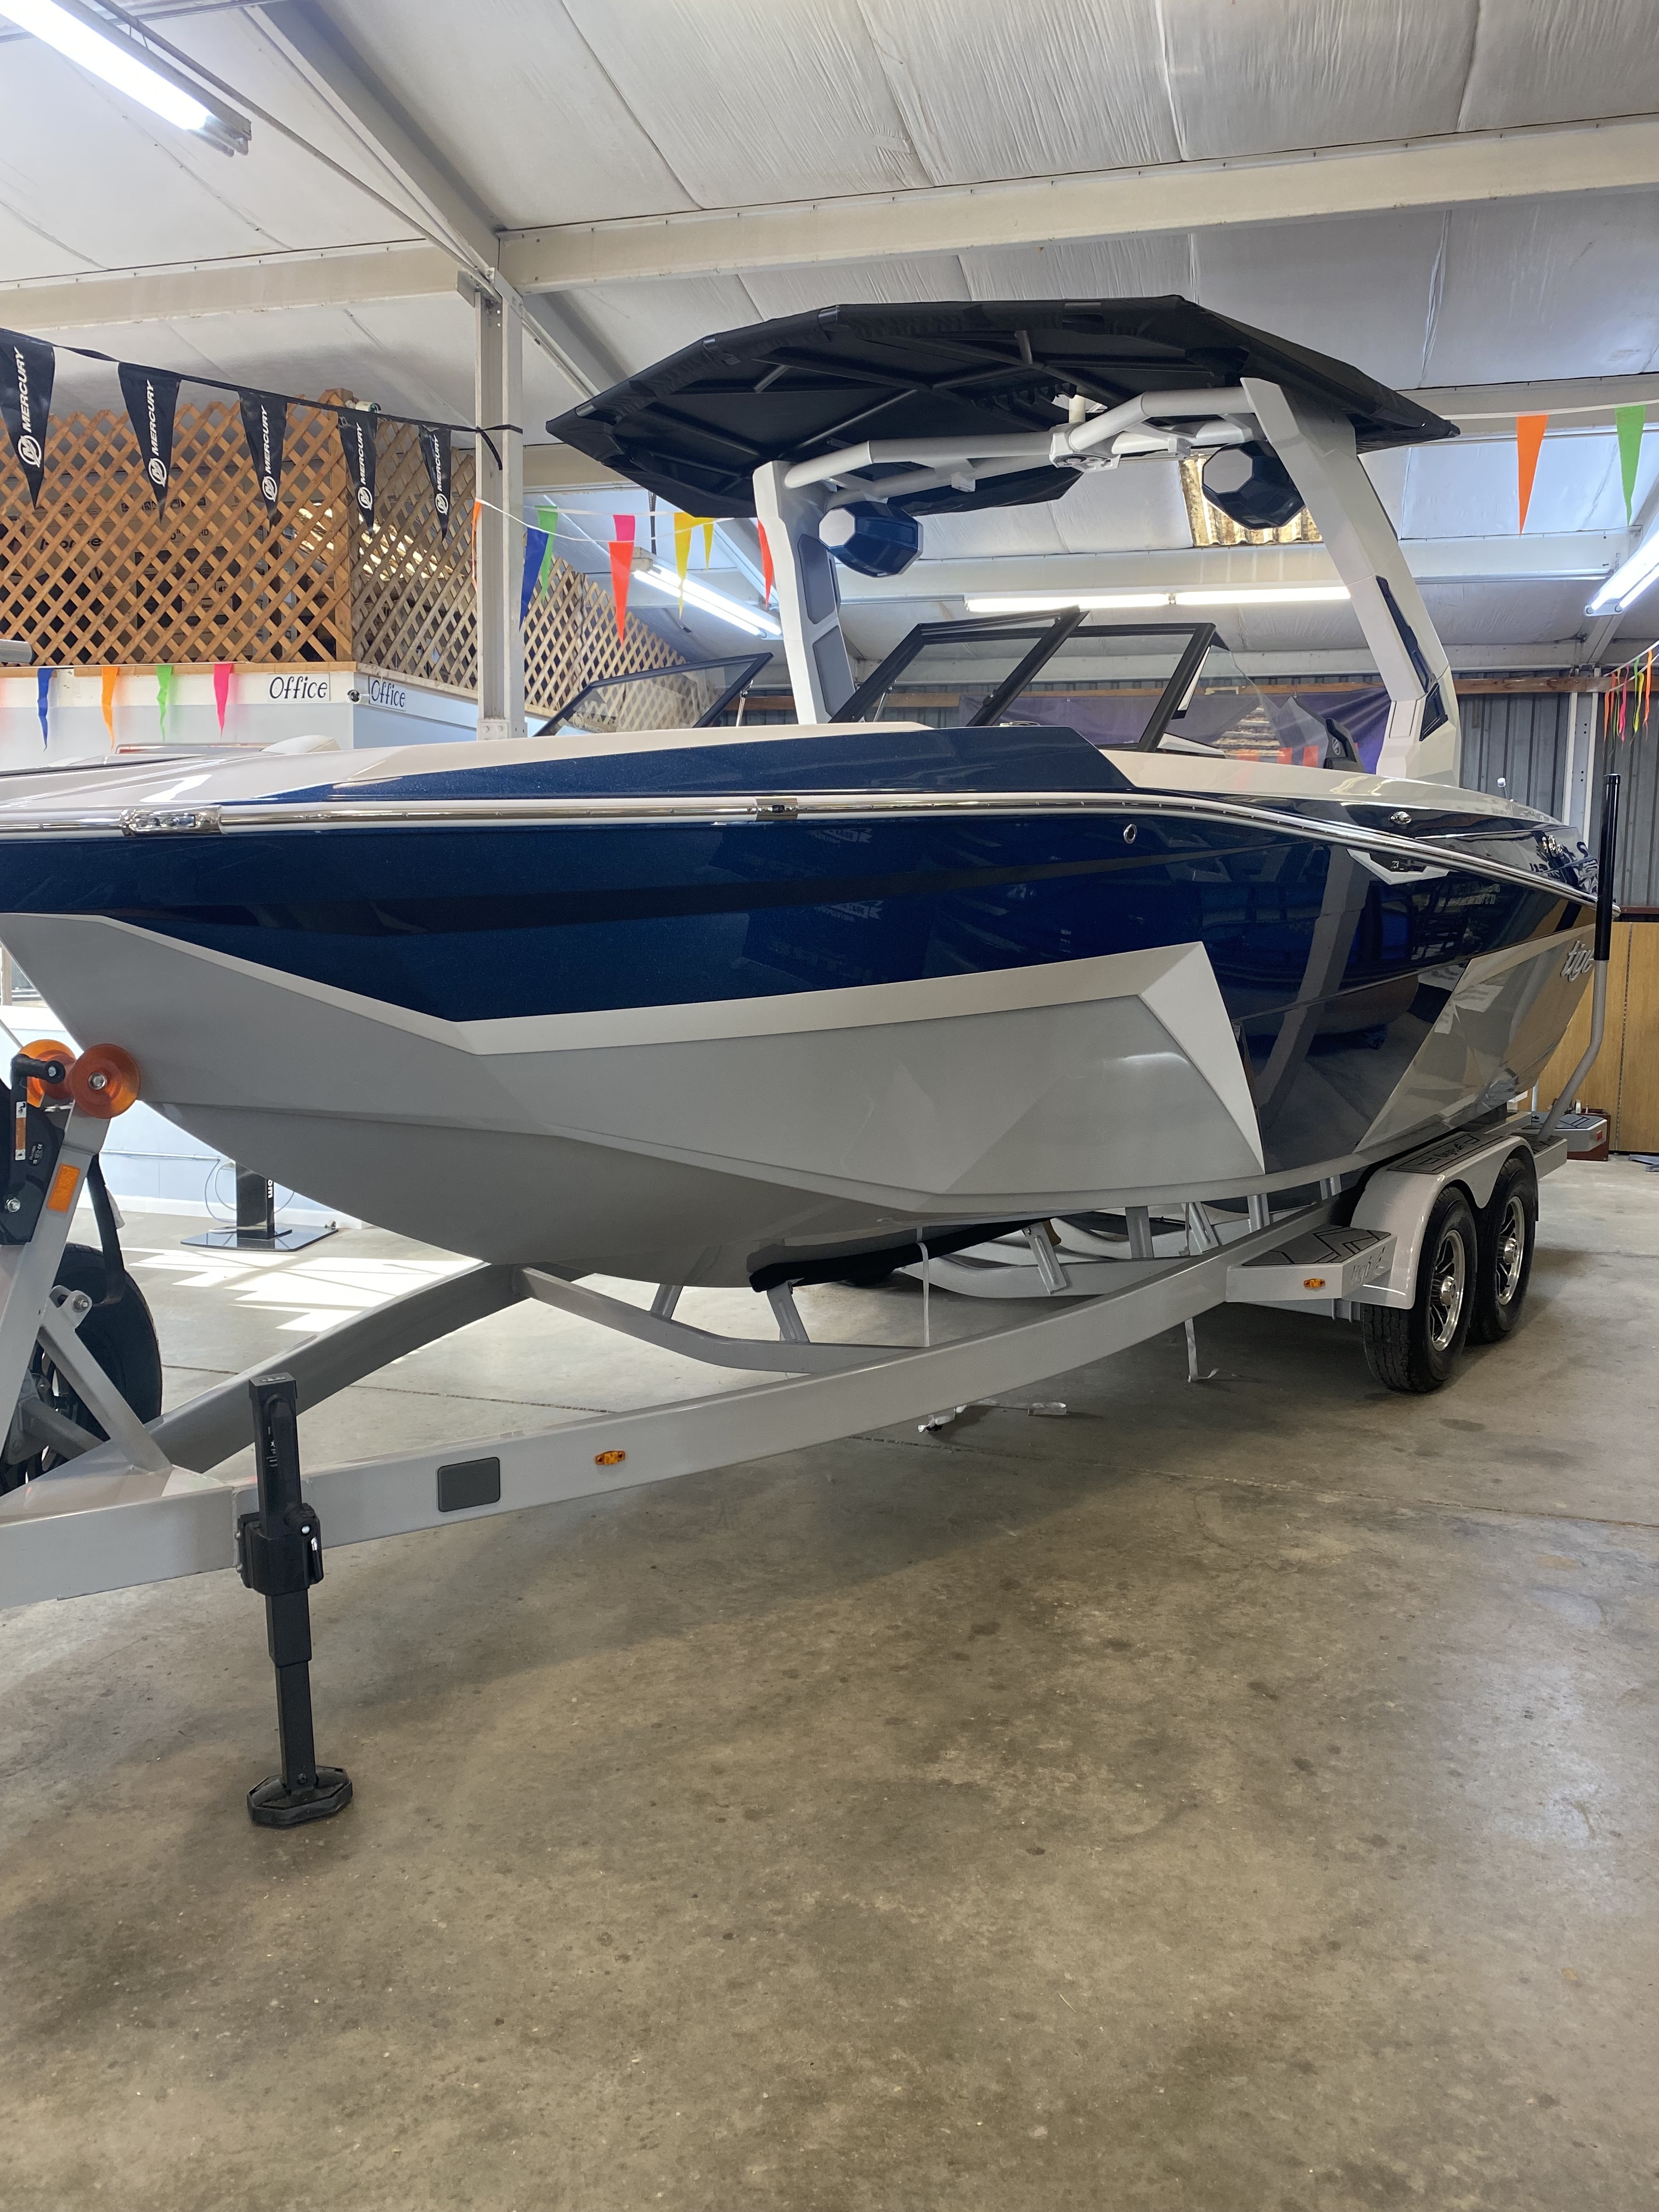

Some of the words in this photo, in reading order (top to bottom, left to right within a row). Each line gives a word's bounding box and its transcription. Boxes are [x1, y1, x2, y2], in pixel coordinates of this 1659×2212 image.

[13, 346, 32, 433] MERCURY
[146, 379, 159, 456] MERCURY
[261, 404, 272, 475] MERCURY
[356, 421, 366, 485] MERCURY
[433, 433, 443, 492] MERCURY
[269, 676, 328, 699] Office
[371, 680, 406, 708] Office
